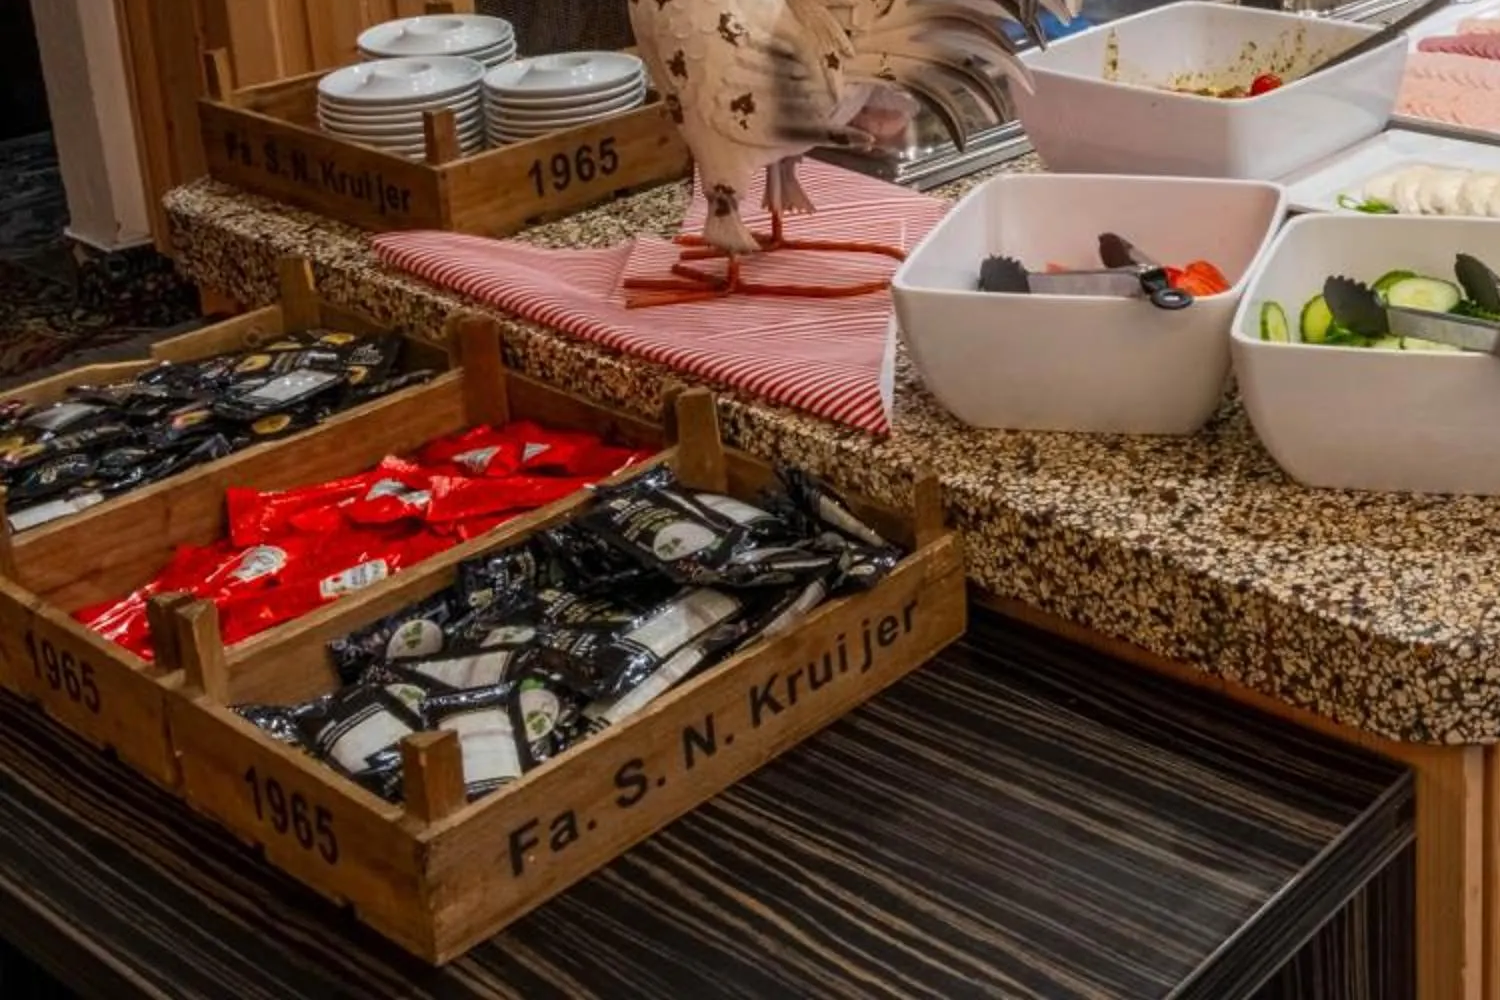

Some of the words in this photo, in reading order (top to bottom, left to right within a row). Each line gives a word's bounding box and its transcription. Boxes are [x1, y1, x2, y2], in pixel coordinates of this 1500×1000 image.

[527, 136, 618, 198] 1965
[24, 629, 100, 715] 1965
[508, 809, 597, 878] Fa.
[613, 756, 667, 810] S.
[682, 713, 735, 771] N.
[748, 599, 919, 729] Kruijer
[244, 765, 339, 867] 1965
